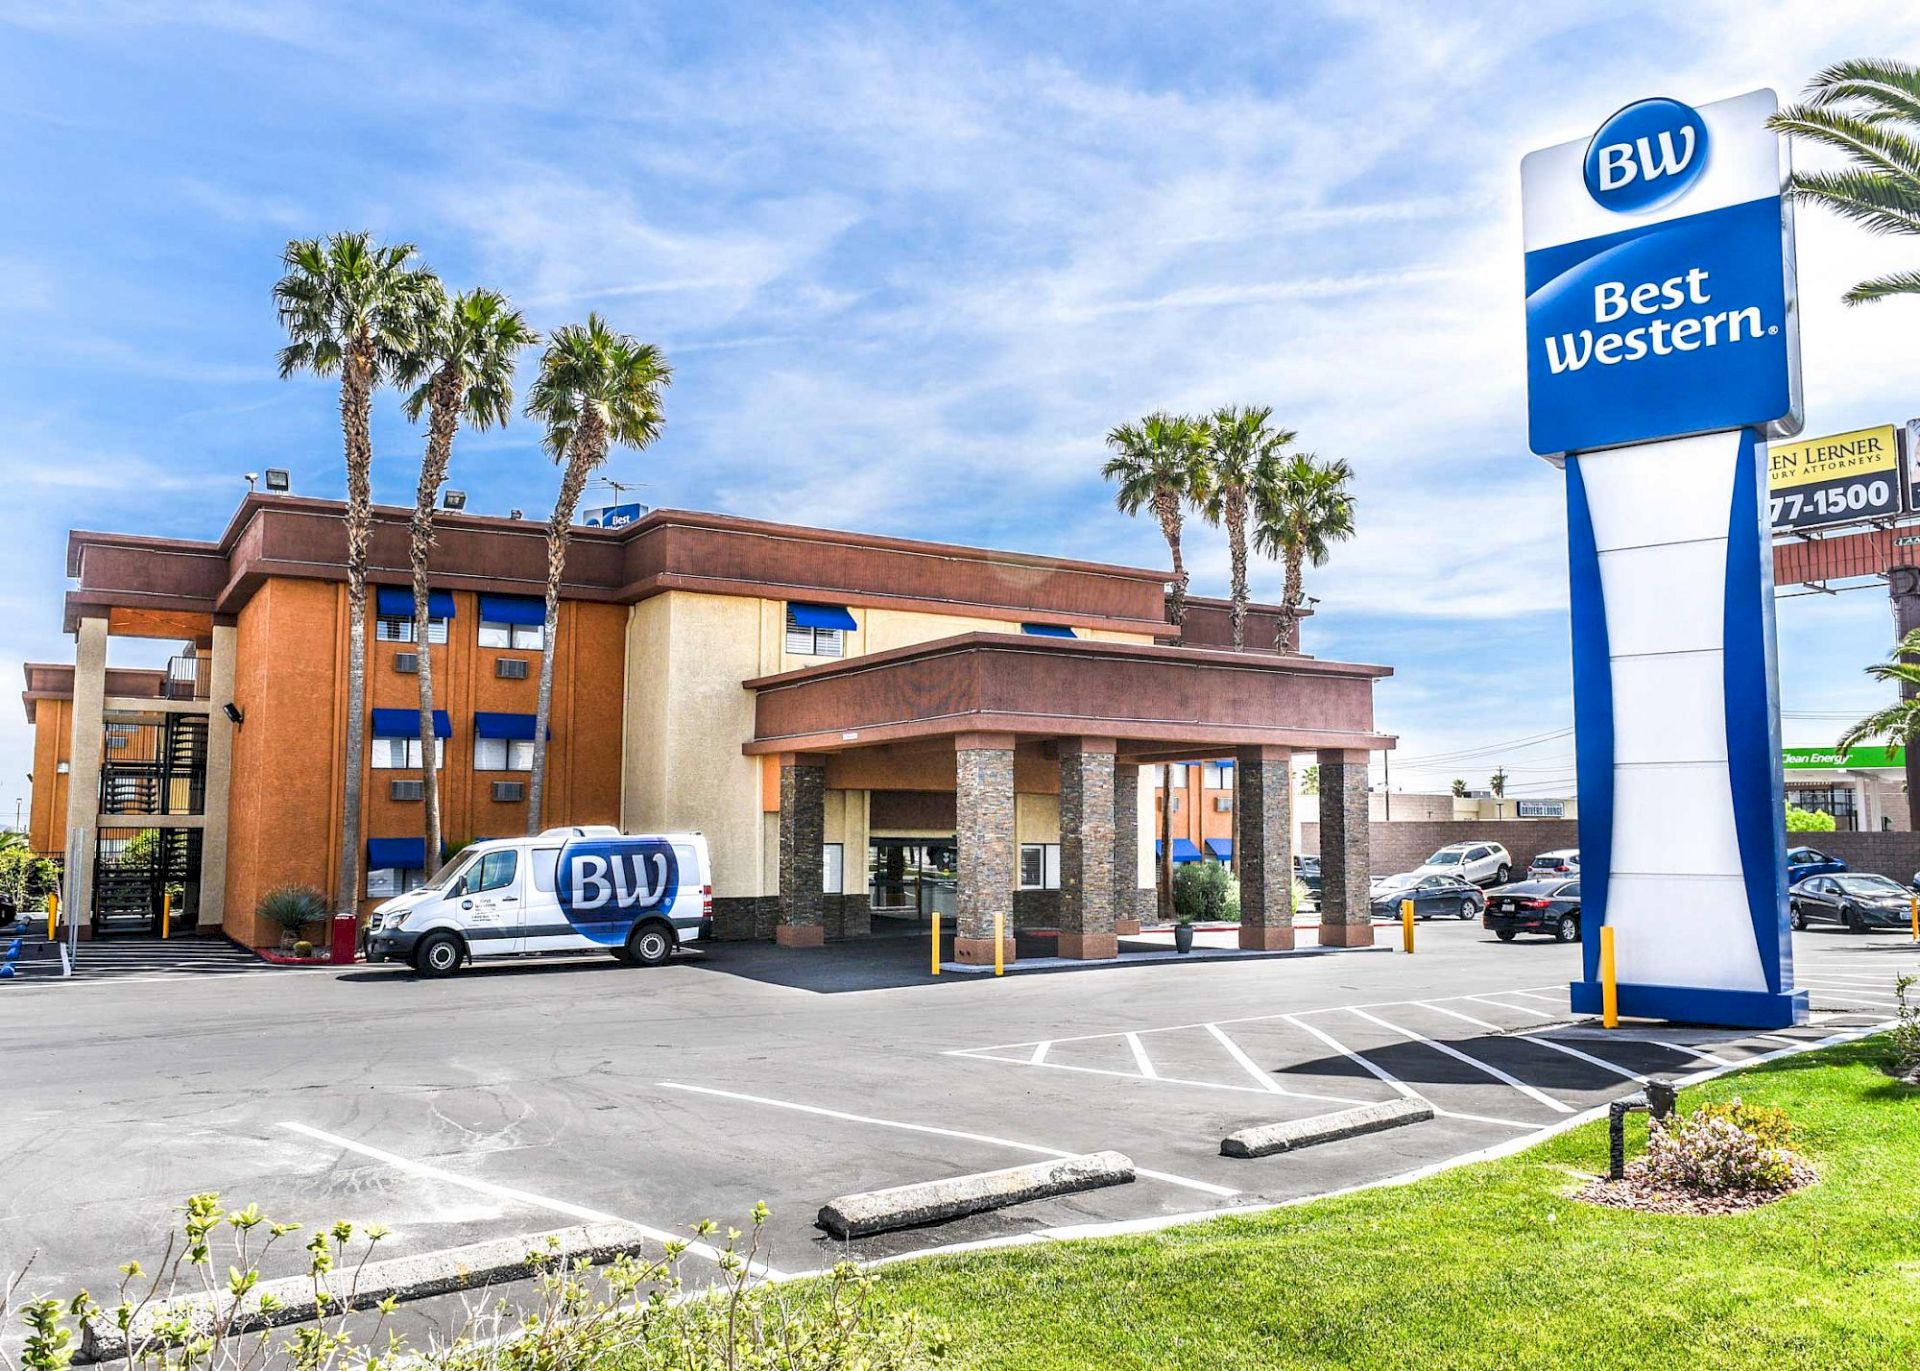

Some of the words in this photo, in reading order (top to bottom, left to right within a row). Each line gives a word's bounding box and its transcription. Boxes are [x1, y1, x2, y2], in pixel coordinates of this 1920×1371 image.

[1599, 124, 1696, 192] BW
[1594, 267, 1711, 324] Best
[1769, 453, 1797, 471] EN
[1805, 437, 1884, 465] LERNER
[1803, 453, 1882, 475] ATTORNEYS
[612, 515, 630, 525] Best
[1770, 480, 1890, 523] 77-1500
[1810, 753, 1851, 765] Energy
[571, 852, 668, 910] BW
